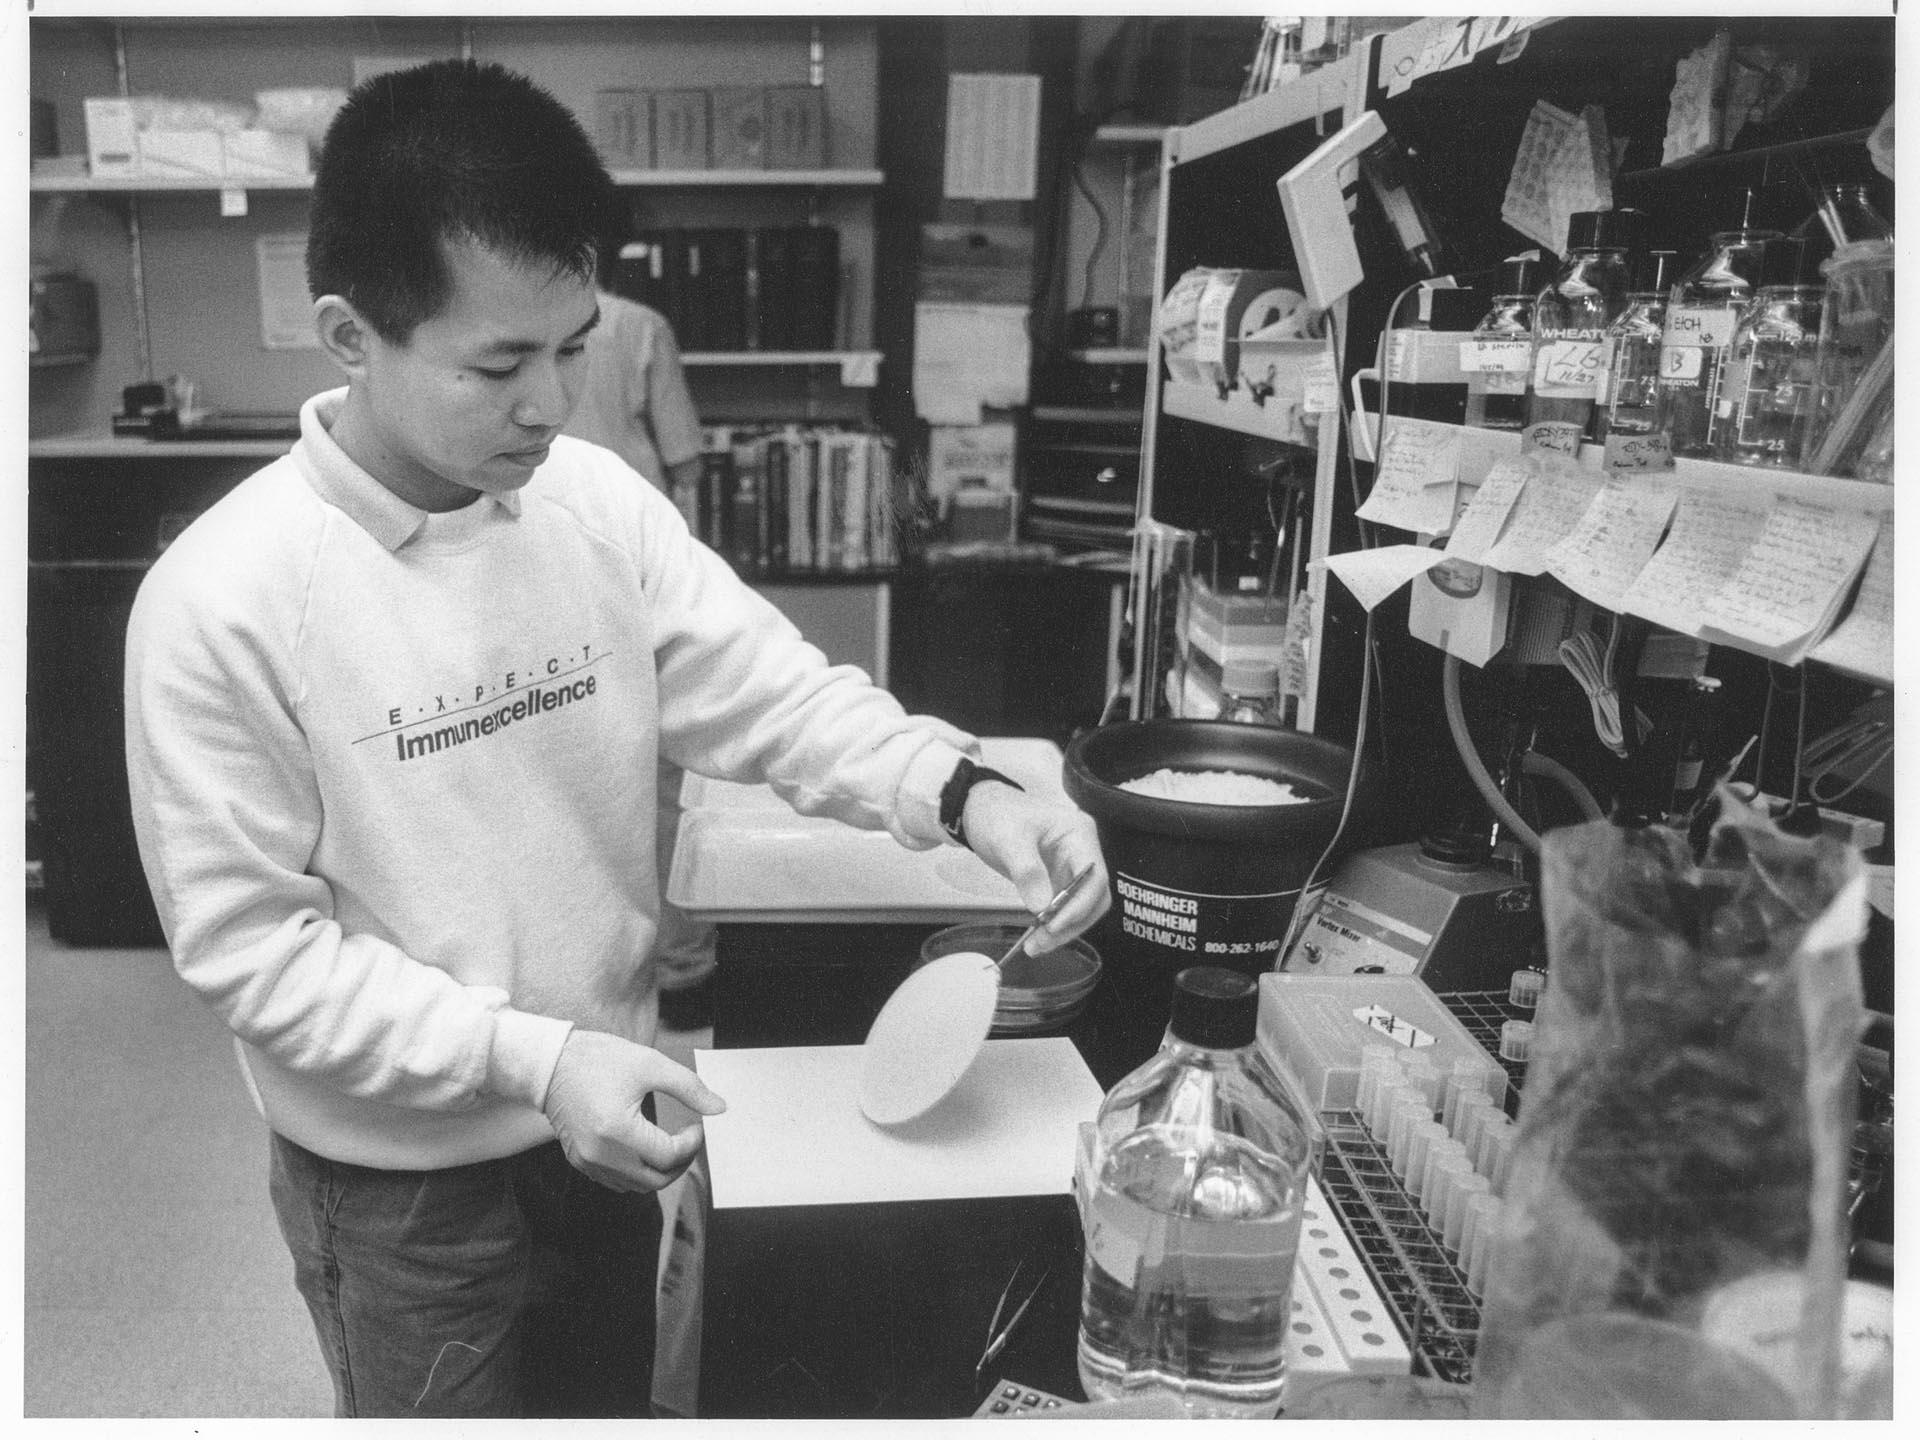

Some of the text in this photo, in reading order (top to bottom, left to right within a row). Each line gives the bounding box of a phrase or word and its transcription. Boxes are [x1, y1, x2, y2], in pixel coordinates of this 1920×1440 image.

[1766, 439, 1785, 451] 25
[396, 675, 597, 762] Immunexcellence
[1116, 879, 1199, 916] BOEHRINGER
[1122, 916, 1197, 952] BIOCHEMICALS
[1123, 899, 1198, 934] MANNHEIM
[1316, 915, 1361, 943] Vortex Mixer
